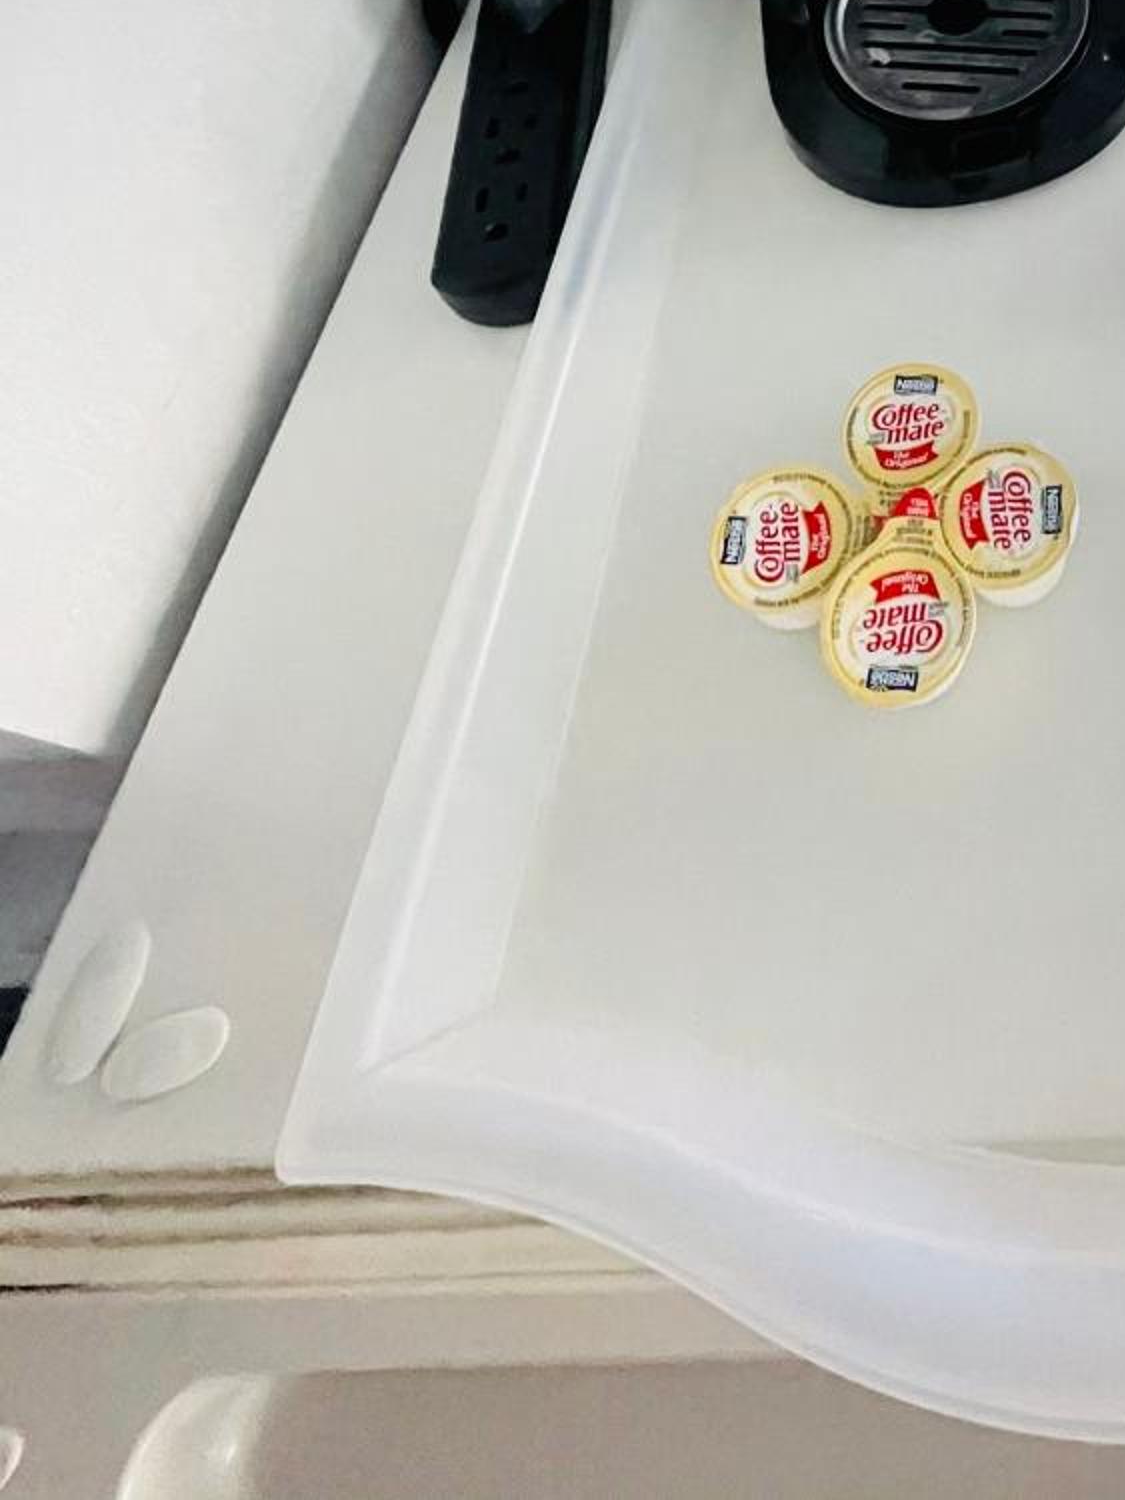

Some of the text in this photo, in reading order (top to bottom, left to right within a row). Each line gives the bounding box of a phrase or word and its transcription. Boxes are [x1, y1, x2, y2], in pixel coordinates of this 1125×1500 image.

[887, 421, 945, 445] mate
[780, 501, 801, 562] mate
[987, 491, 1012, 550] mate
[863, 602, 926, 629] mate
